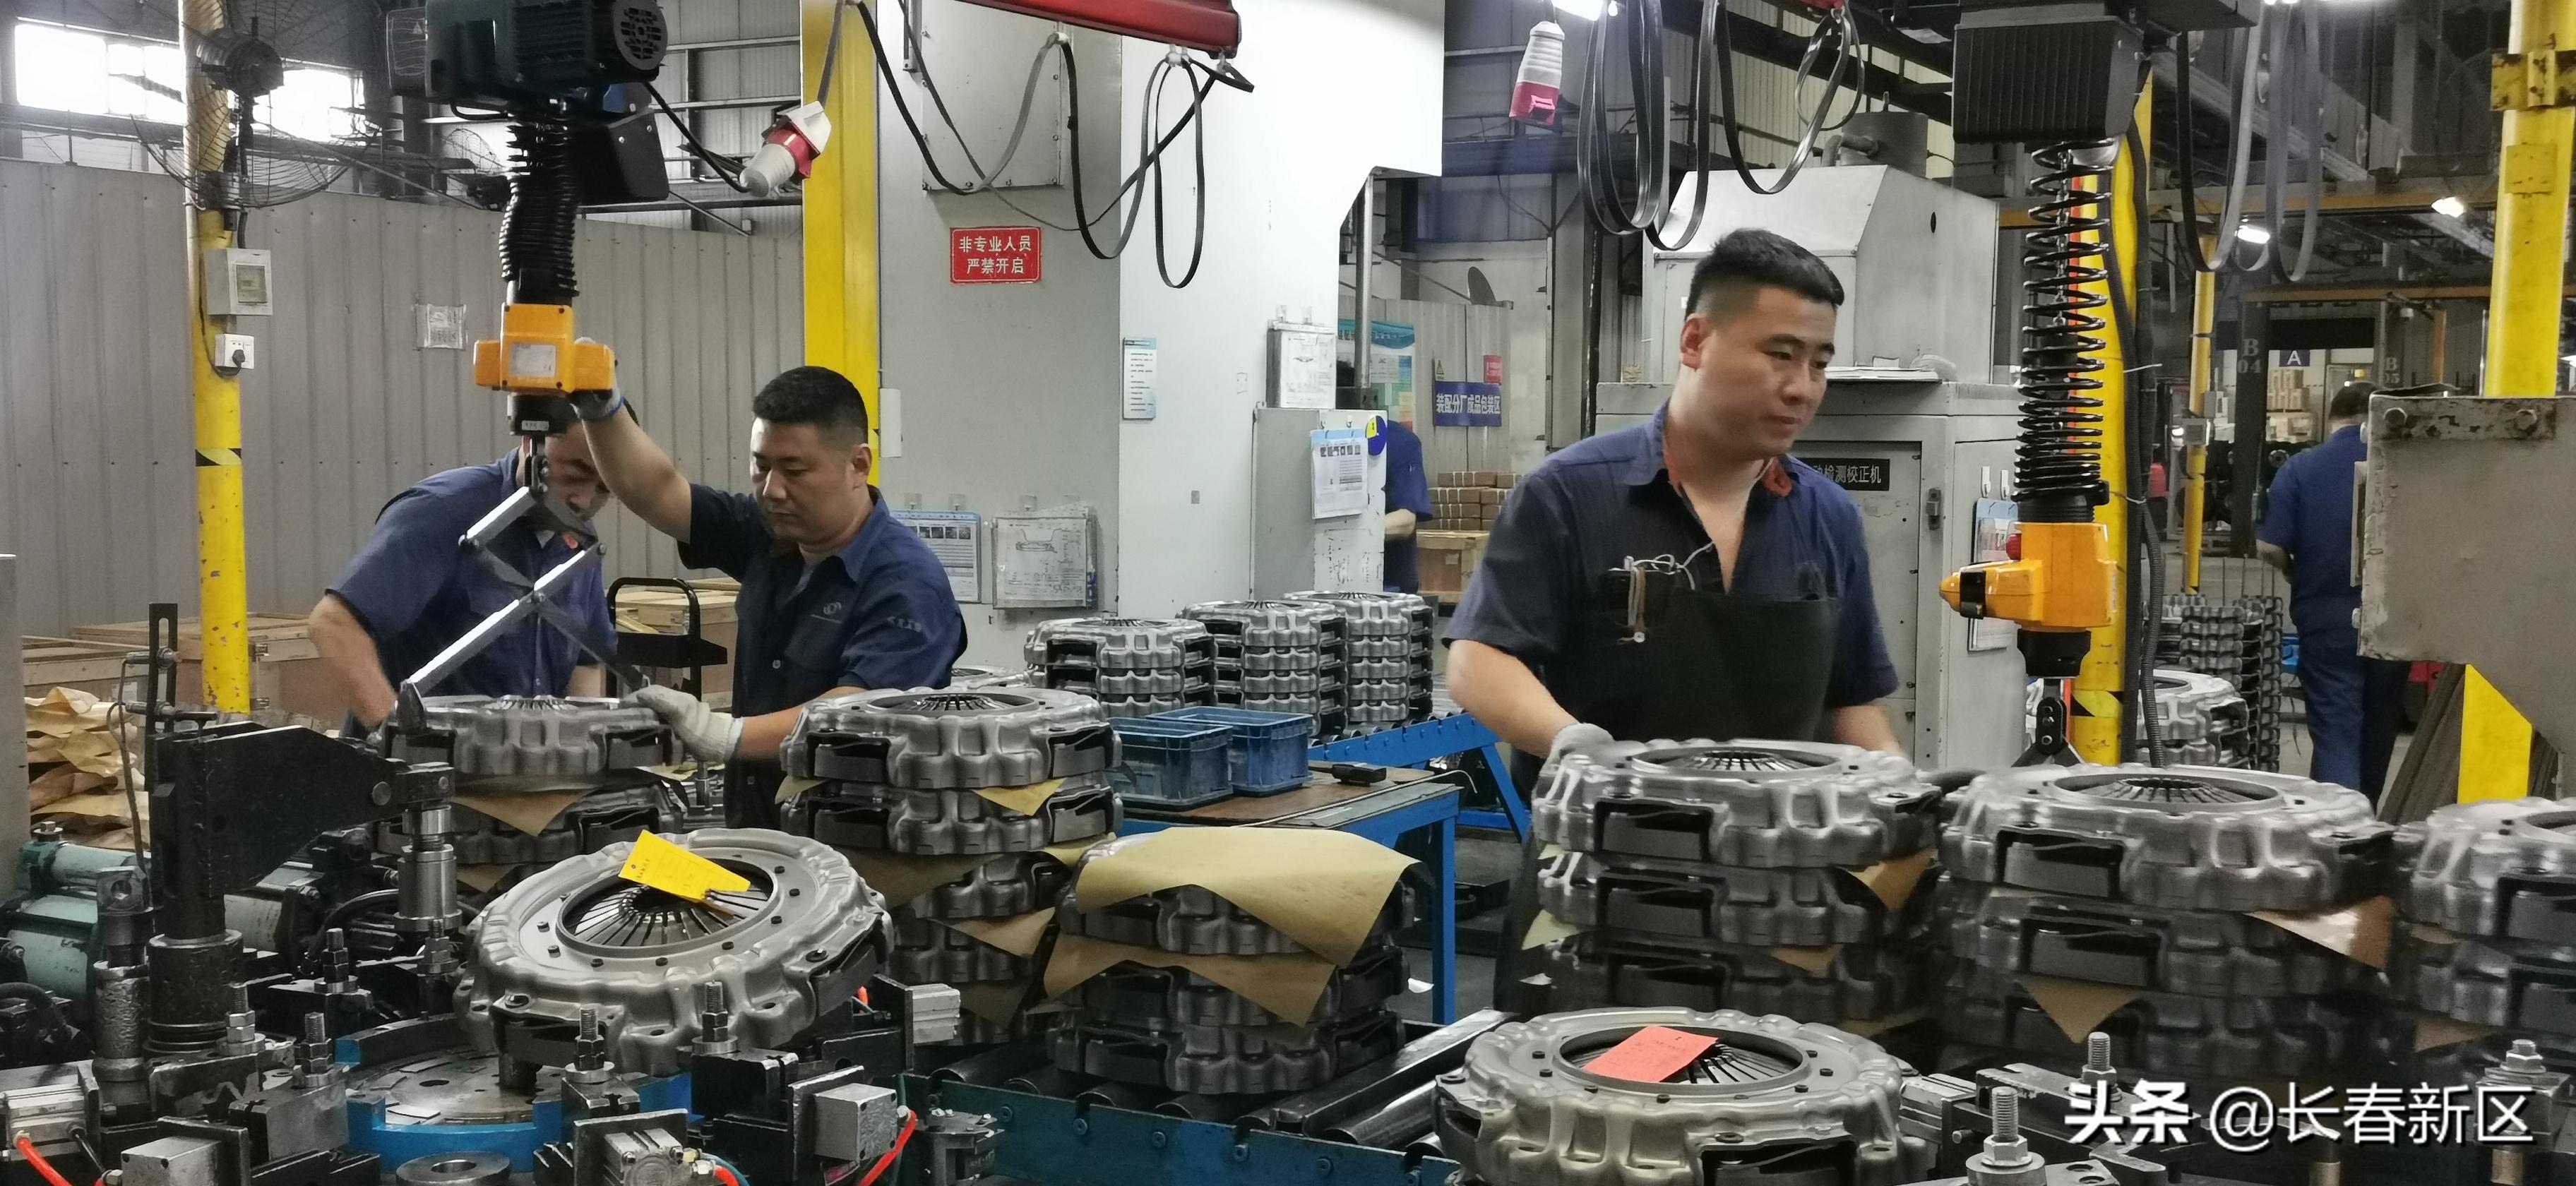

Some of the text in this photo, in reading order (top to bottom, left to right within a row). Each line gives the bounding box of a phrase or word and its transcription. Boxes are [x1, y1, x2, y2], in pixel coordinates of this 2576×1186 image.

[959, 235, 1032, 253] 非专业人员
[967, 256, 1024, 275] 严禁开启
[2242, 338, 2259, 357] B
[2236, 359, 2262, 373] 04
[2286, 349, 2302, 366] A
[1436, 393, 1501, 415] 装配分厂成品包装区
